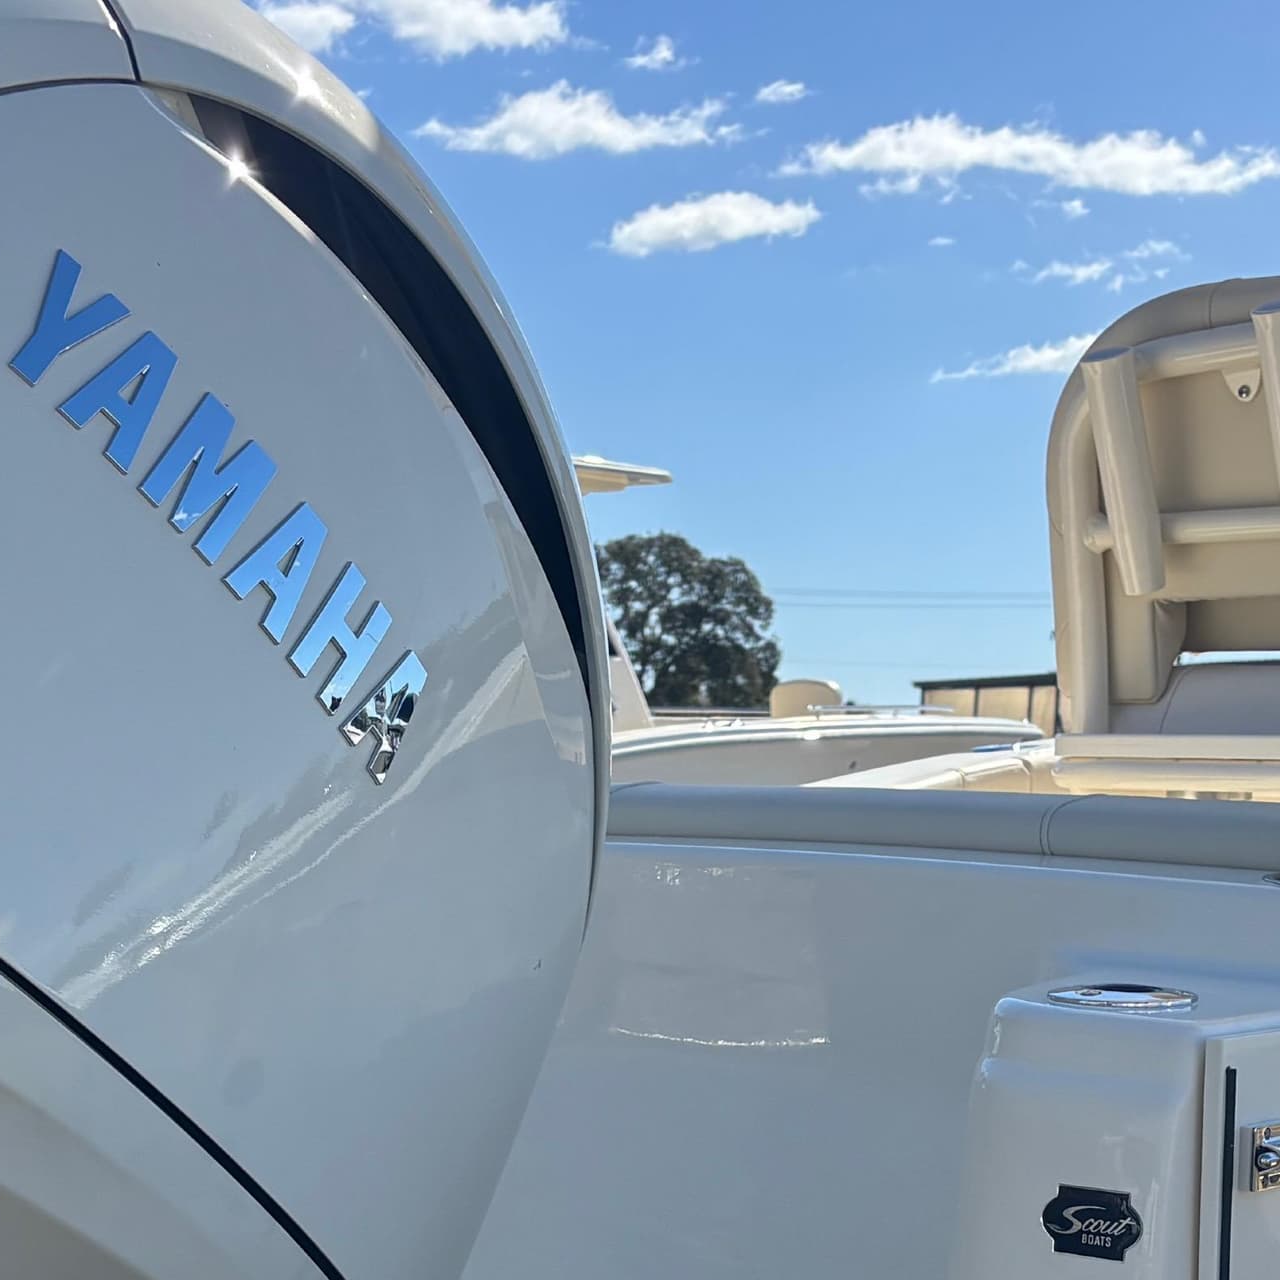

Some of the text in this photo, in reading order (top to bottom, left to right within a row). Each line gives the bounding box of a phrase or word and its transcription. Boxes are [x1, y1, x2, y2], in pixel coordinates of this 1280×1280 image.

[8, 248, 428, 785] YAMAHA
[1047, 1205, 1136, 1236] Scout
[1081, 1233, 1112, 1248] BOATS
